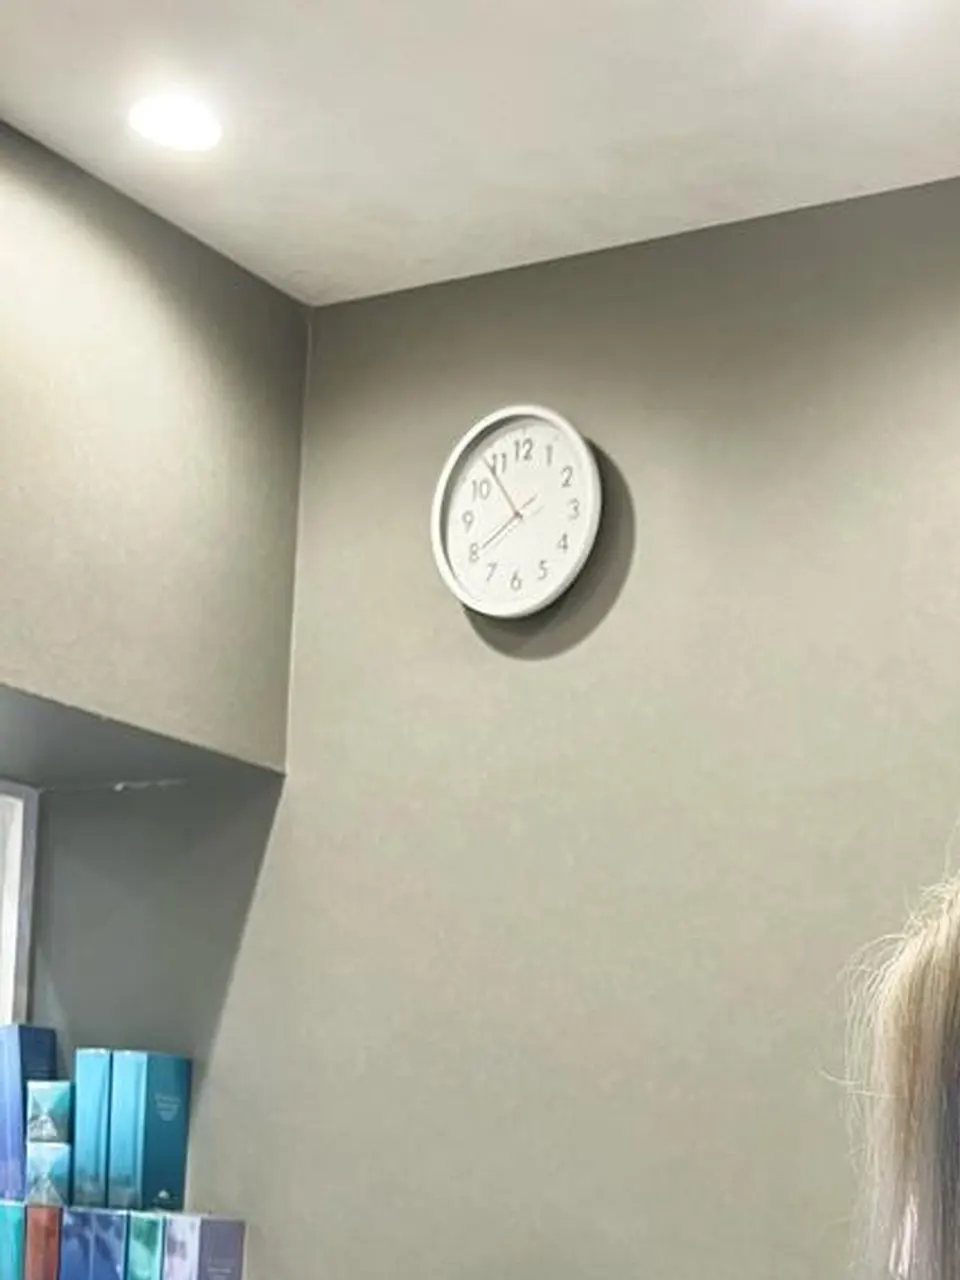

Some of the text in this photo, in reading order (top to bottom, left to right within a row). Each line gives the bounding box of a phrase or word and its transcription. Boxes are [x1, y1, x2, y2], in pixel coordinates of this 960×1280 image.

[514, 438, 534, 462] 12
[545, 445, 553, 466] 1
[492, 453, 507, 475] 11
[560, 466, 573, 488] 2
[471, 479, 491, 500] 10
[568, 498, 580, 521] 3
[461, 510, 474, 534] 9
[467, 541, 480, 563] 8
[558, 533, 569, 553] 4
[486, 562, 497, 582] 7
[510, 569, 522, 592] 6
[537, 560, 549, 581] 5
